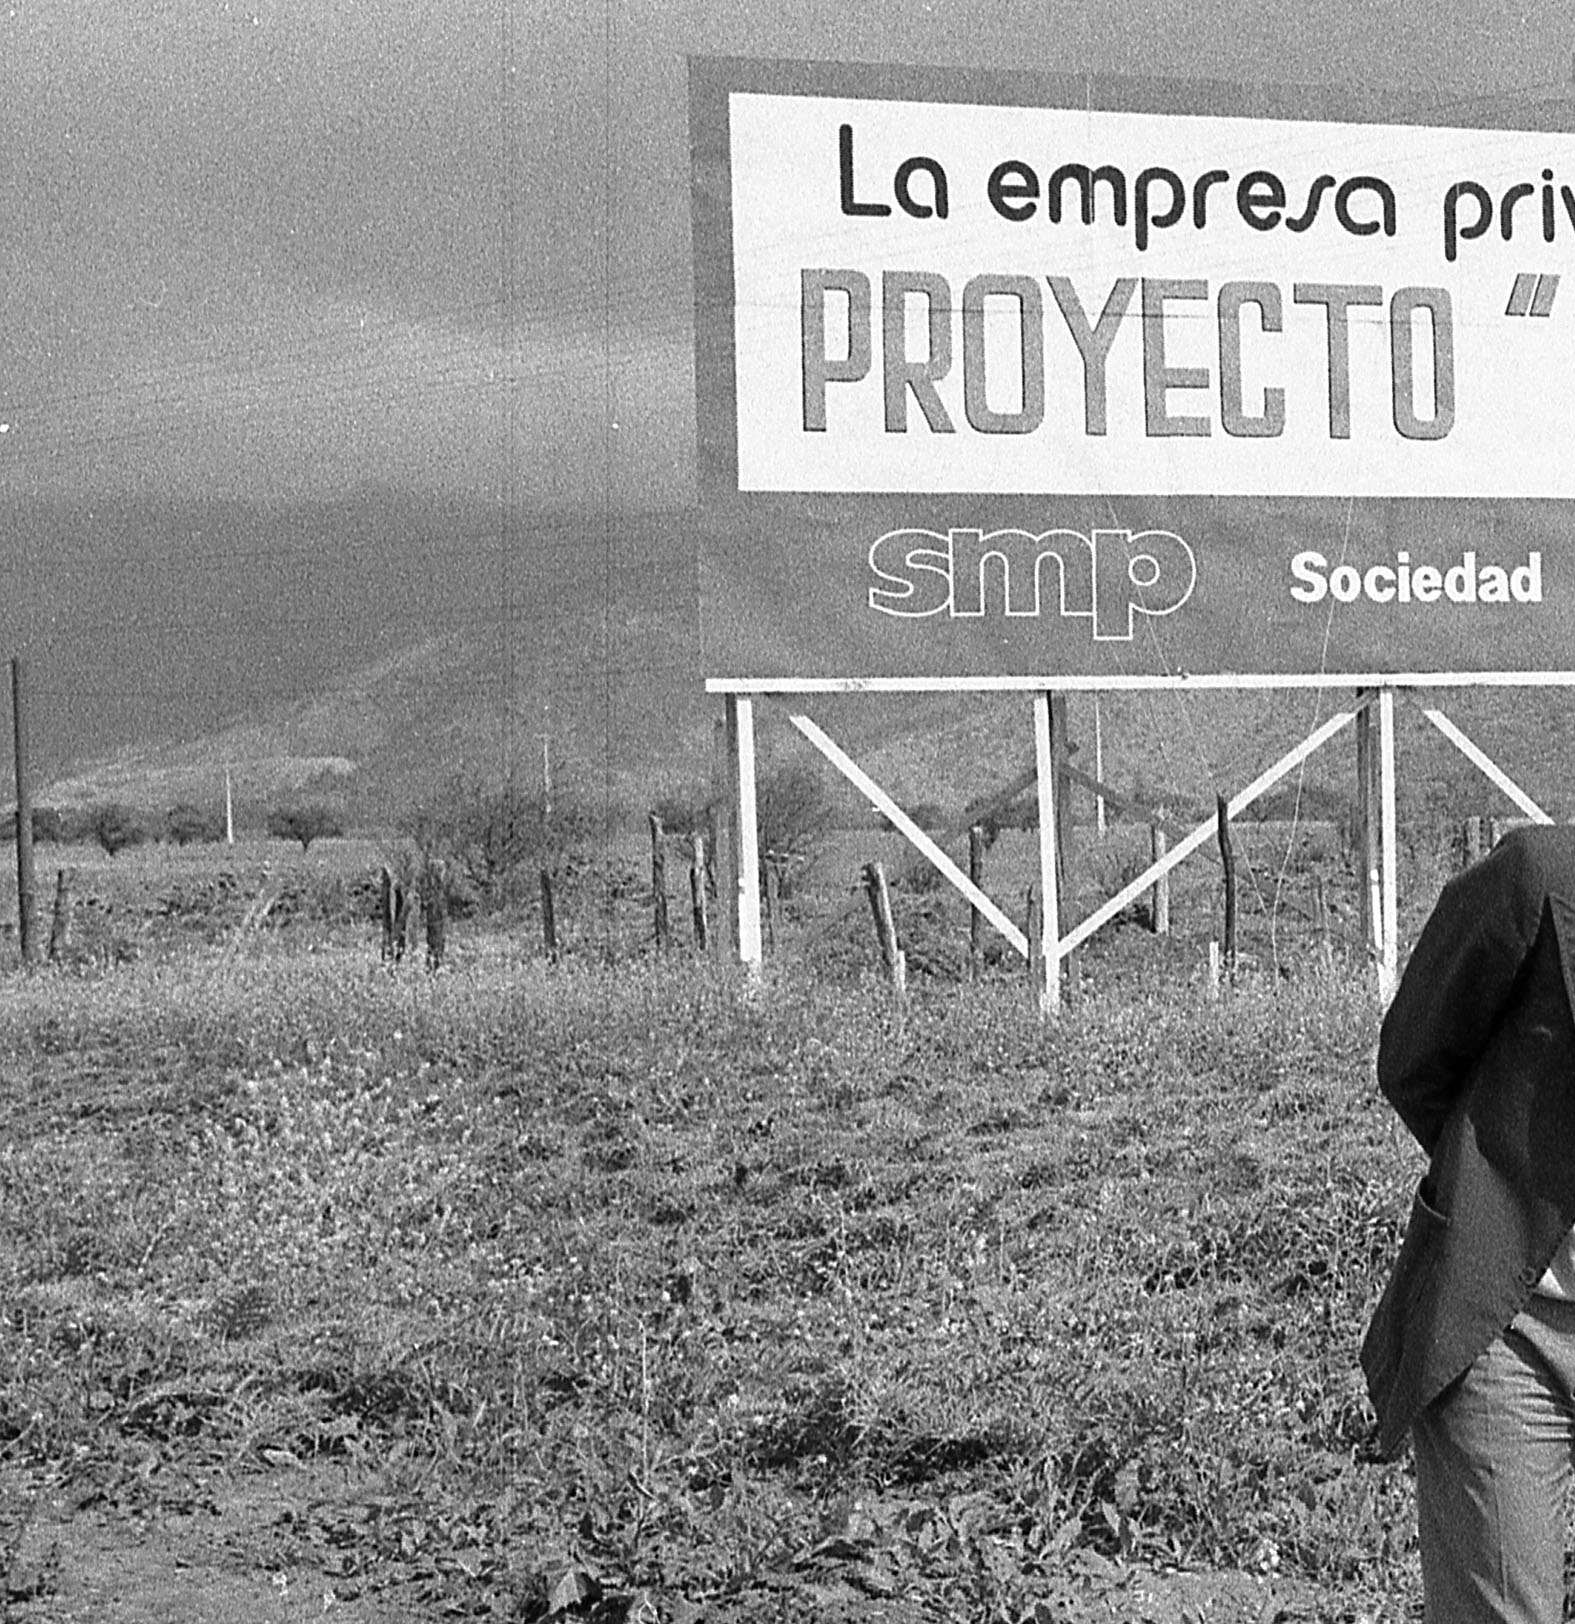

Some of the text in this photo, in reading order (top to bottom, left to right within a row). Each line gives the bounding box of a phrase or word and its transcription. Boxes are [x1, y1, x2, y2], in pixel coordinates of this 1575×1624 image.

[839, 124, 949, 219] La
[987, 160, 1397, 251] empresa
[801, 268, 1455, 441] PROYECTO
[868, 529, 1197, 641] smp
[1290, 550, 1543, 604] Sociedad
